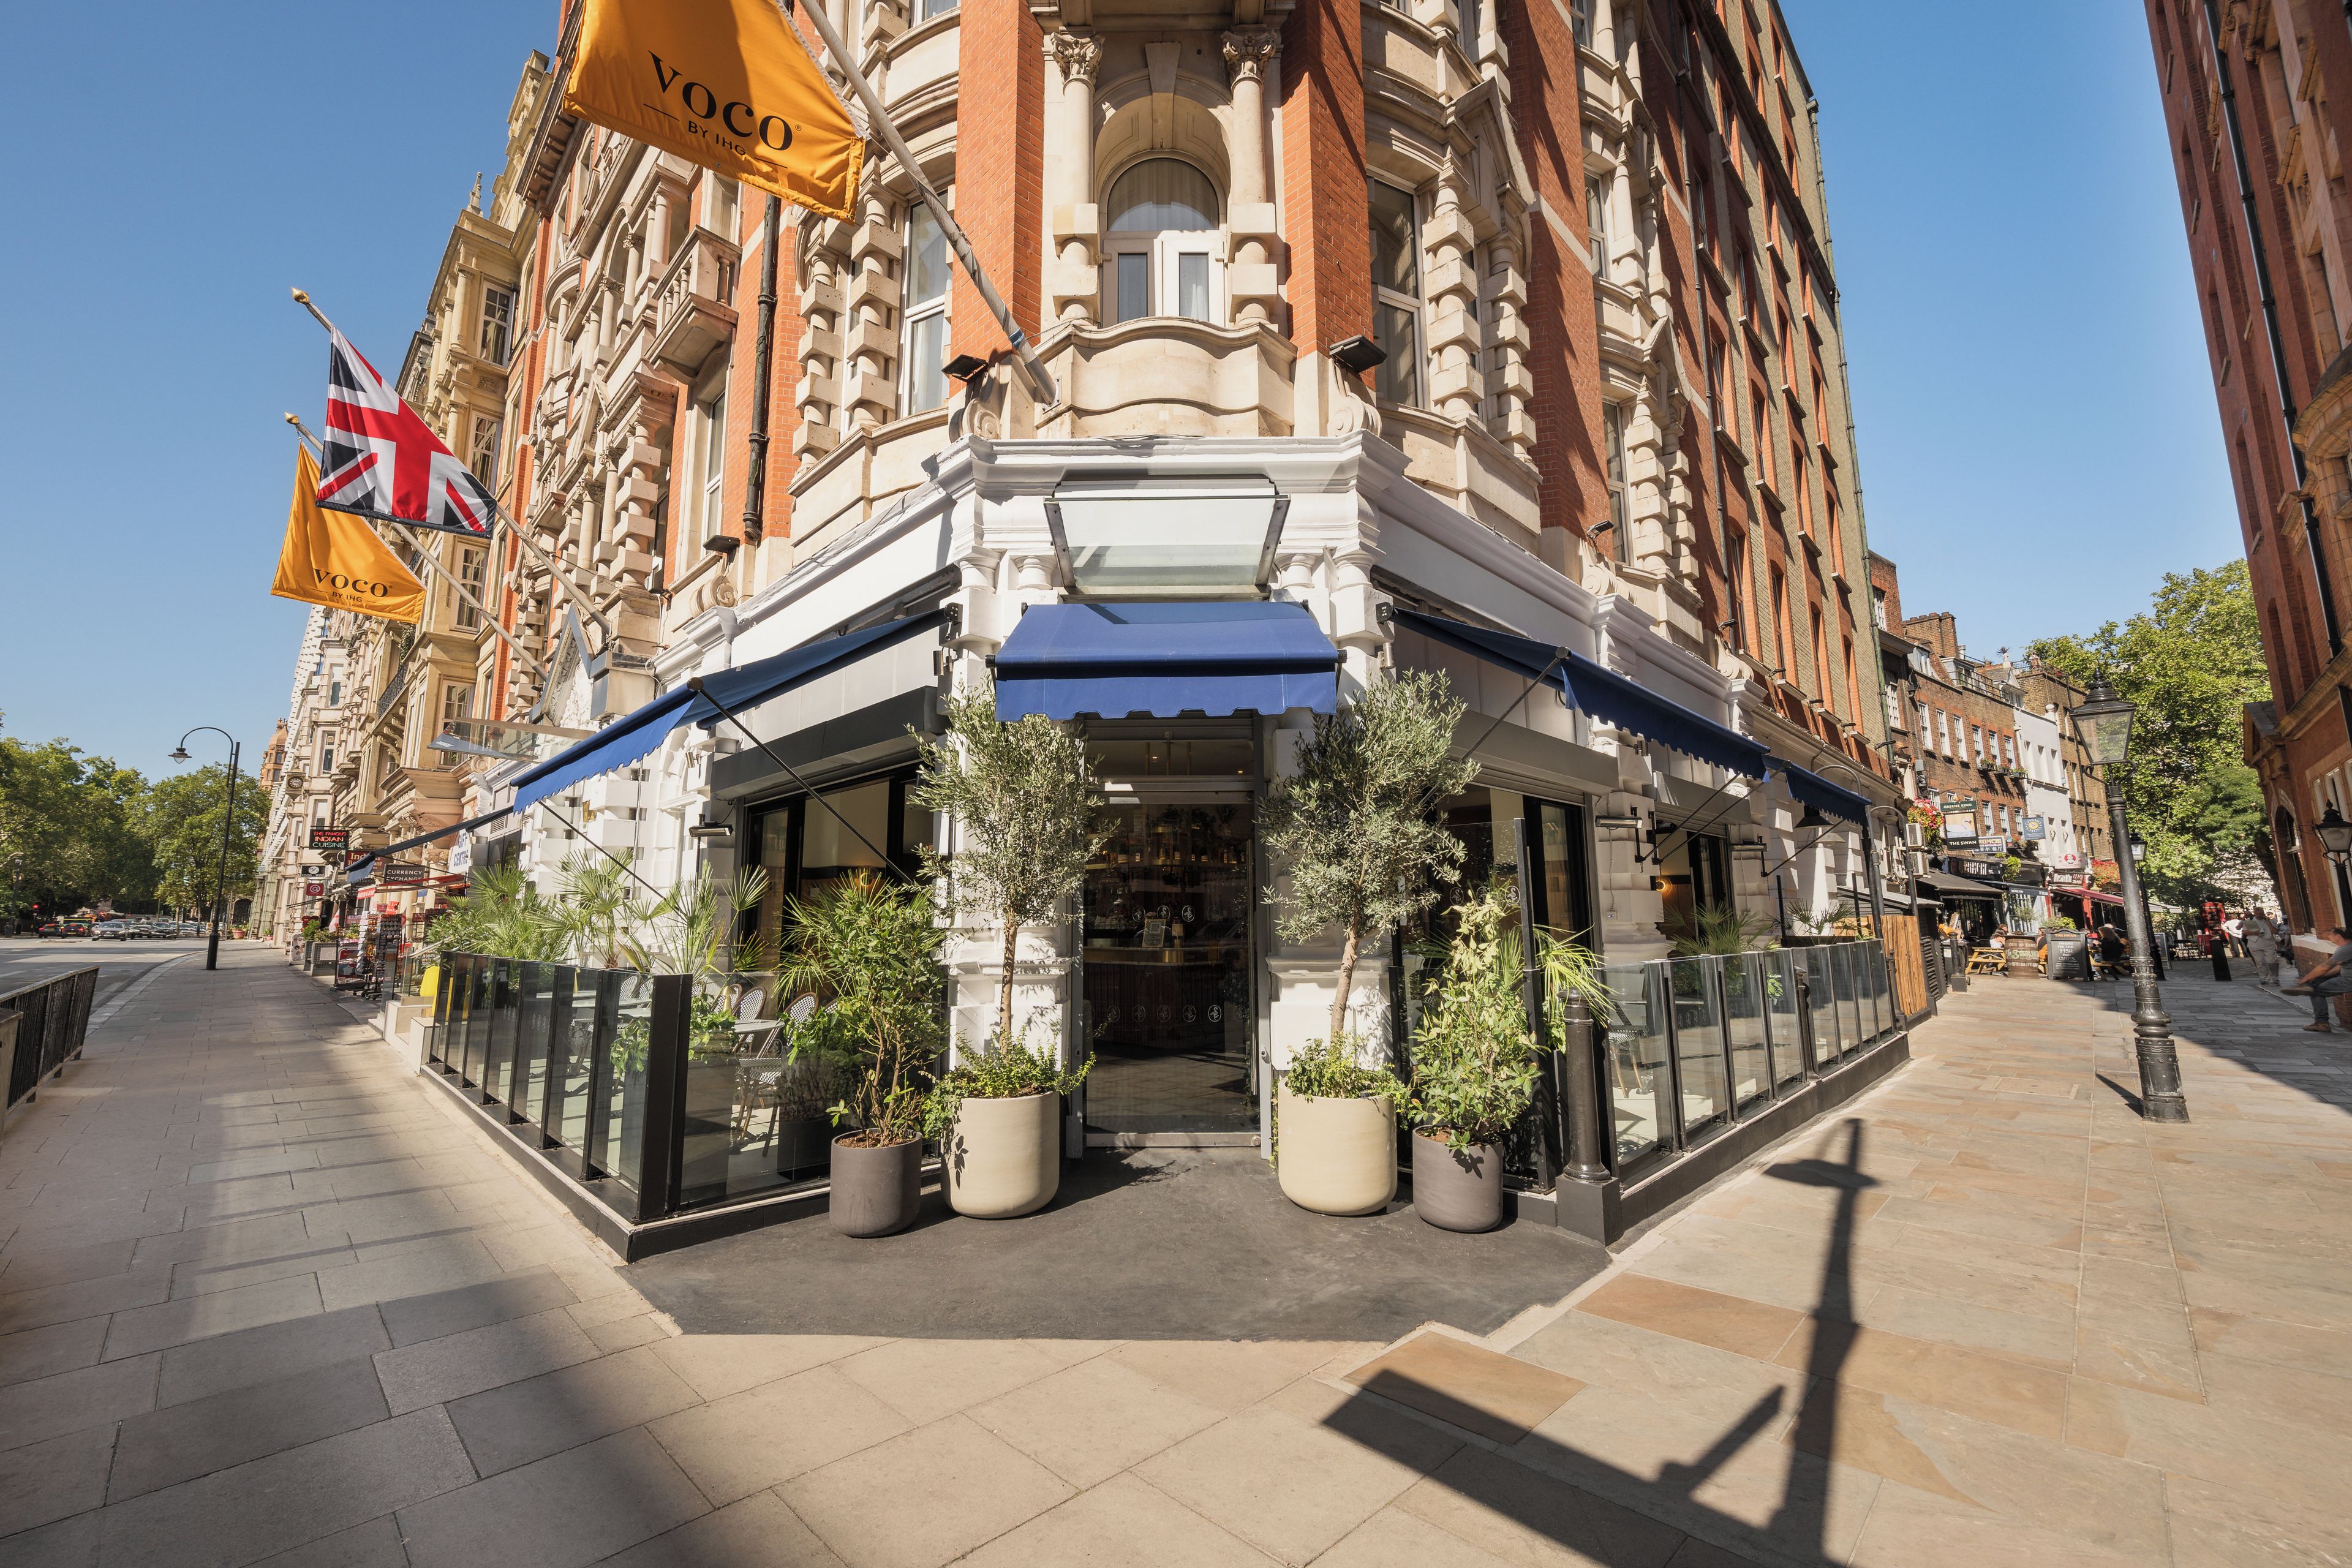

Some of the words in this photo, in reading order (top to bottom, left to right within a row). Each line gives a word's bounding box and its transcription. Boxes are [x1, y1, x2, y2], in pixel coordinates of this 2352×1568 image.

[688, 120, 709, 138] BY
[715, 134, 747, 156] IHG
[458, 832, 467, 848] GIFT
